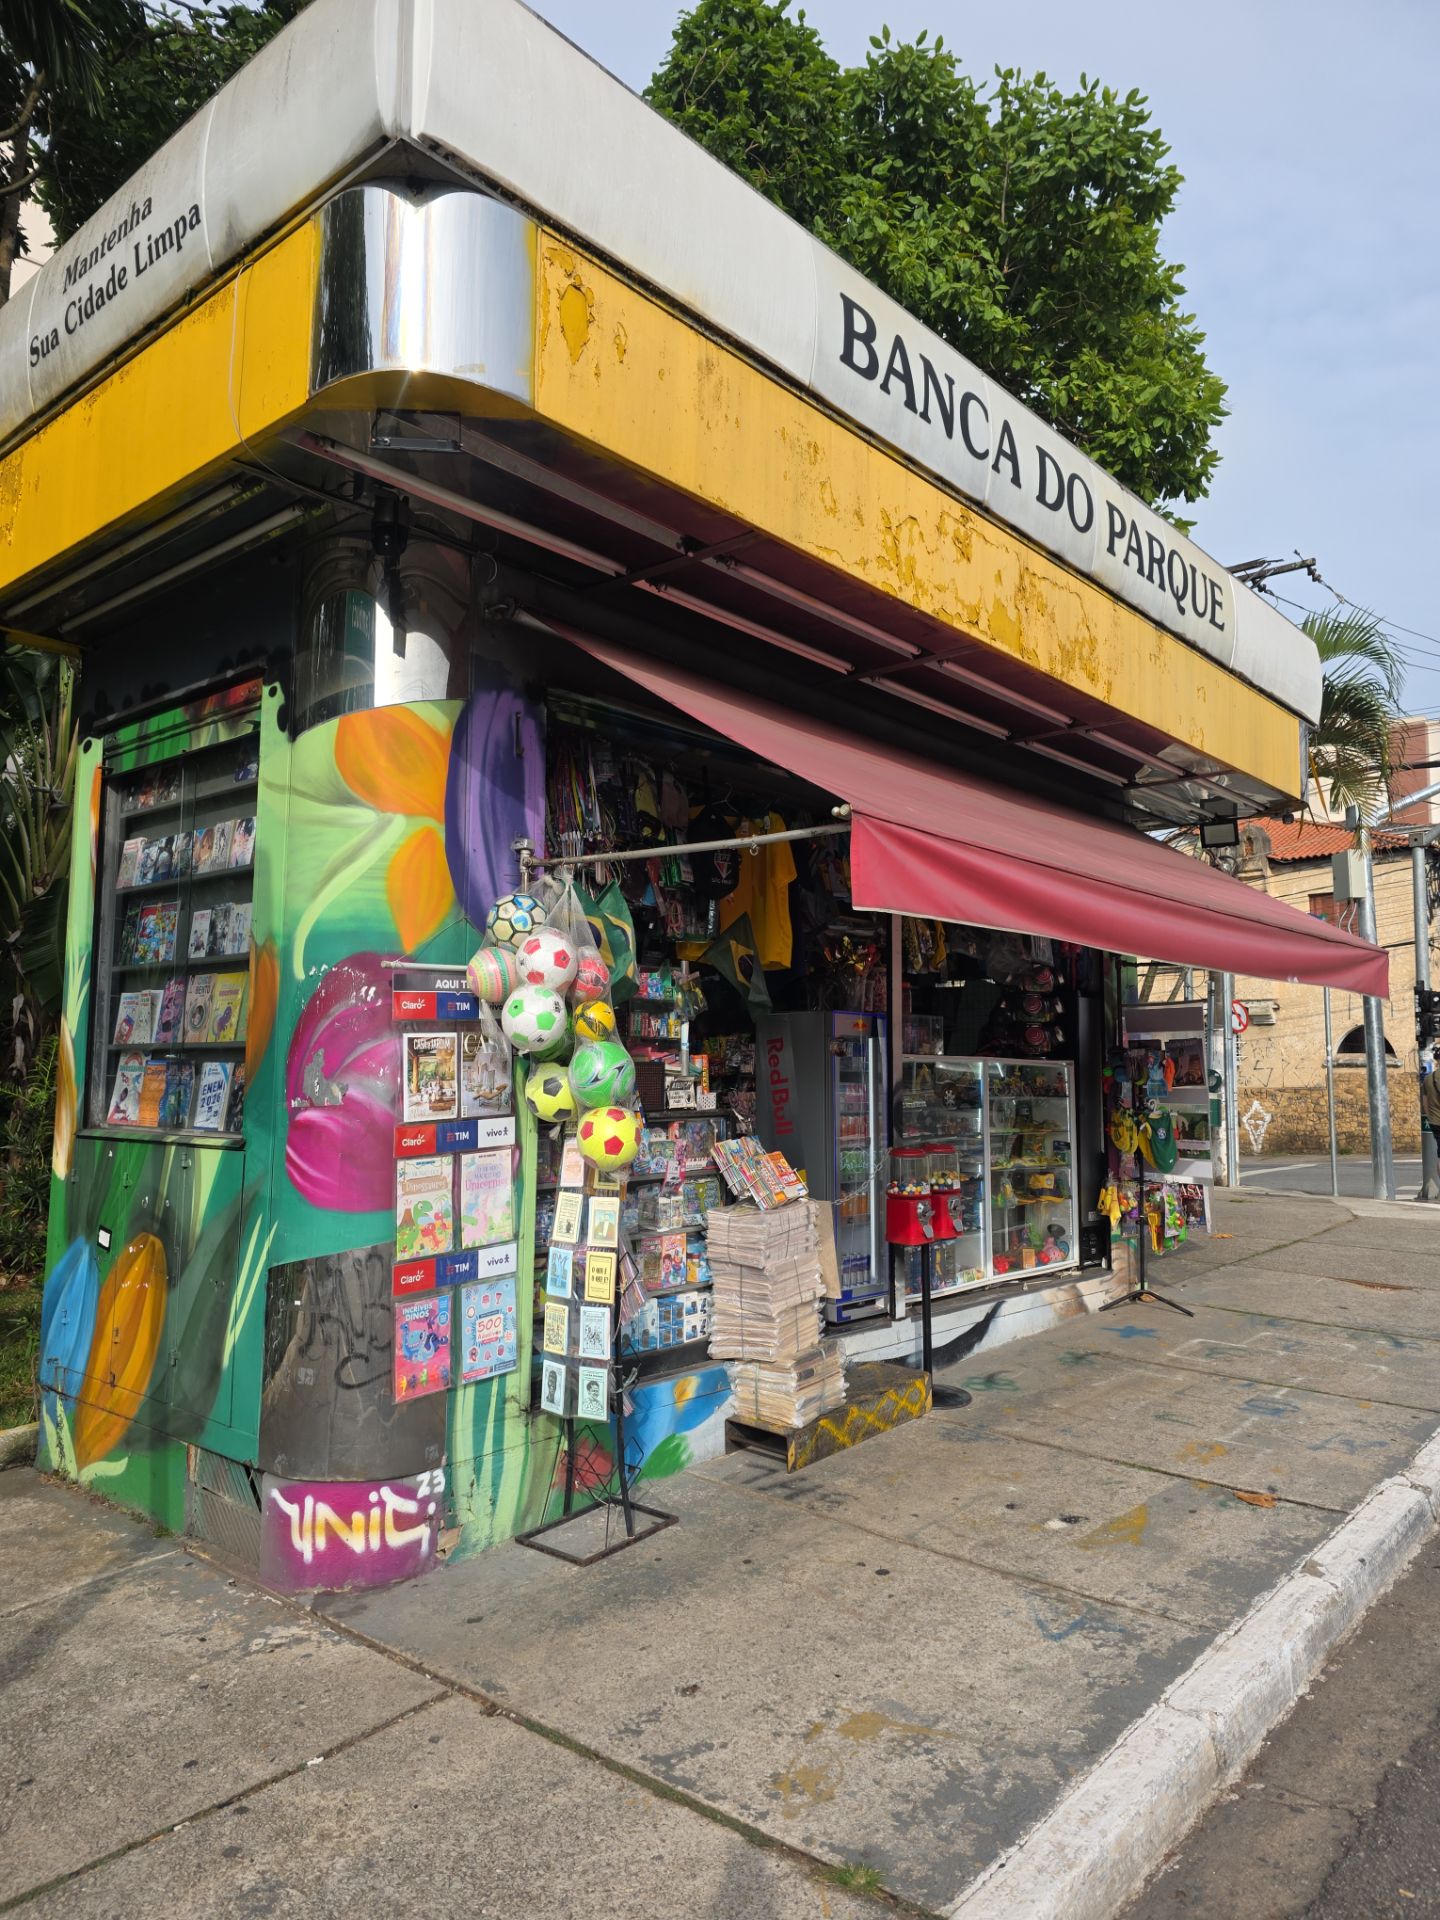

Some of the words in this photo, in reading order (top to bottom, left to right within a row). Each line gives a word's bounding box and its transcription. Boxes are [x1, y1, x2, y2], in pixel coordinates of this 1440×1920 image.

[62, 196, 153, 295] Mantenha
[29, 327, 60, 367] Sua
[64, 263, 128, 335] Cidade
[134, 203, 202, 279] Limpa
[839, 292, 1022, 490] BANCA
[1035, 445, 1095, 533] DO
[1105, 500, 1225, 632] PARQUE
[435, 979, 459, 989] AQUI
[401, 1000, 423, 1010] Claro
[456, 1002, 471, 1011] TIM
[766, 1036, 789, 1086] Red
[203, 1080, 225, 1096] ENEM
[771, 1088, 794, 1135] Bull
[455, 1131, 470, 1141] TIM
[486, 1128, 502, 1137] vivo
[401, 1137, 422, 1147] Claro
[455, 1262, 470, 1273] TIM
[487, 1257, 503, 1267] vivo
[400, 1273, 421, 1285] Claro
[406, 1310, 430, 1321] DINOS
[478, 1316, 502, 1332] 500
